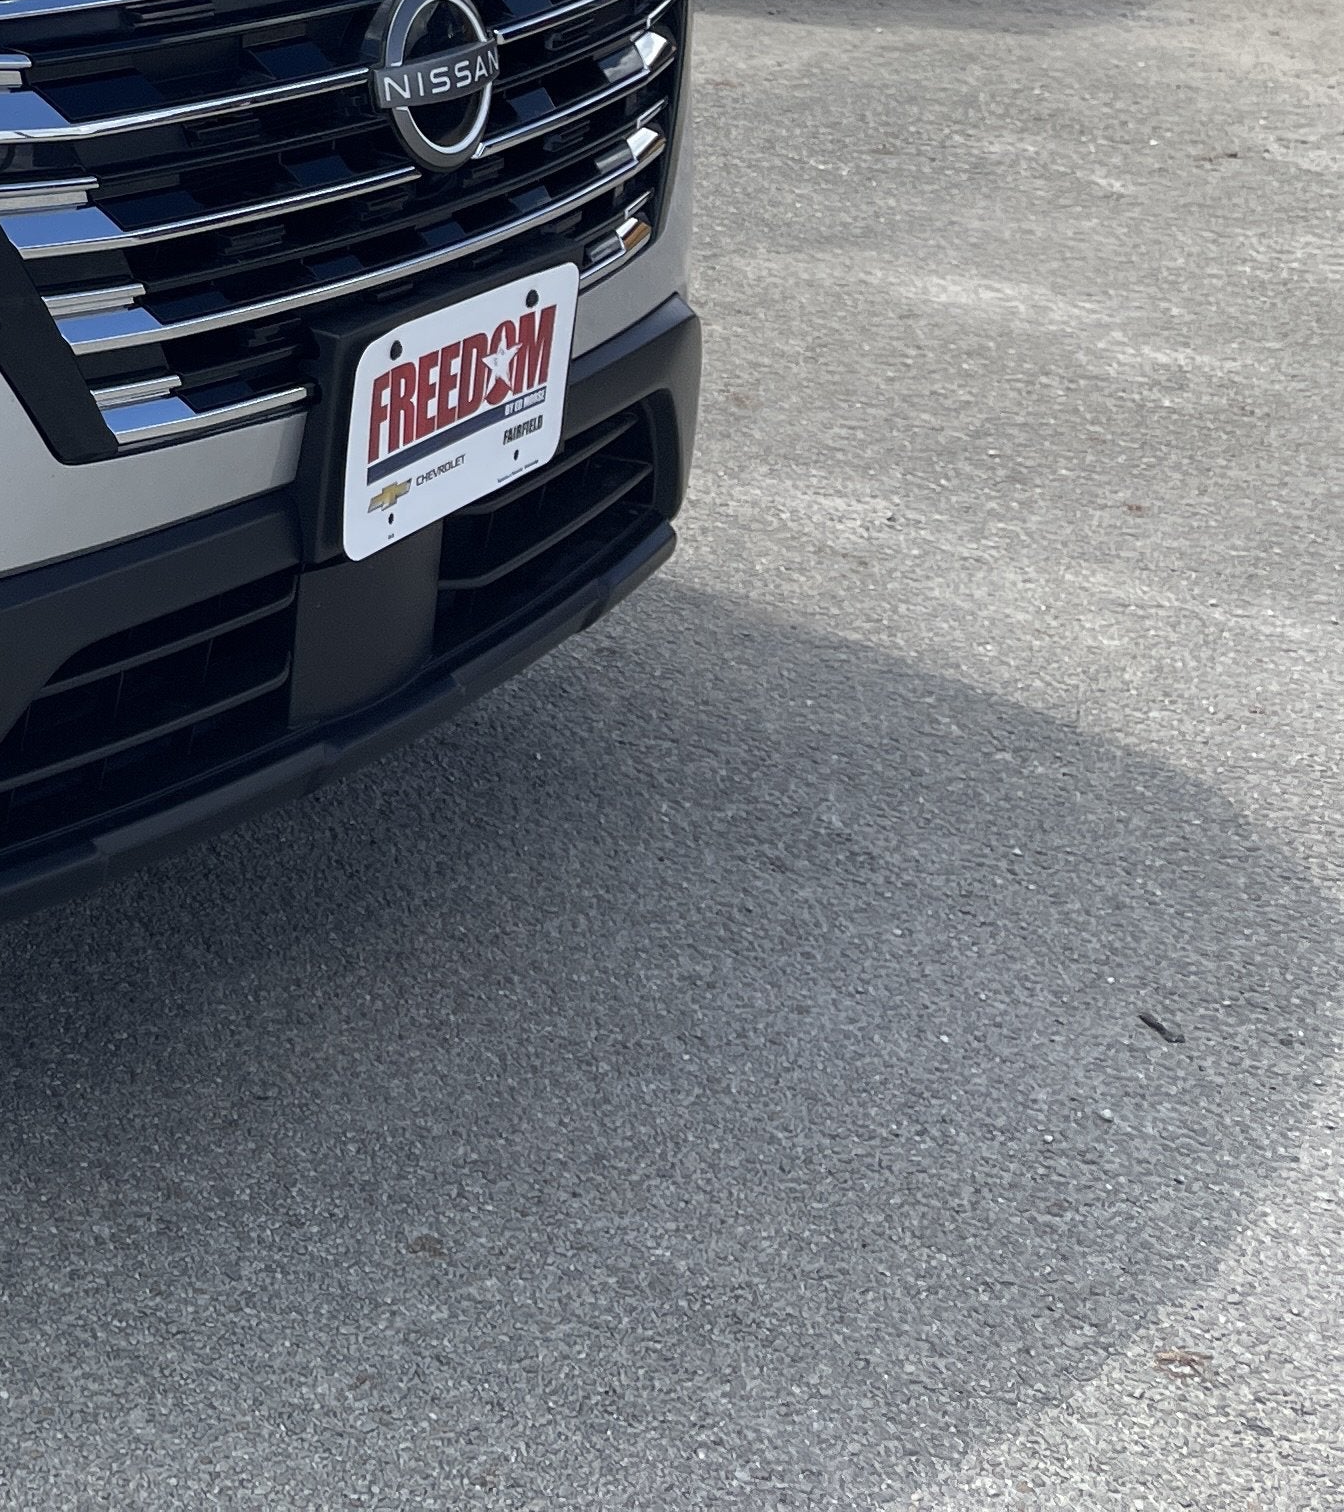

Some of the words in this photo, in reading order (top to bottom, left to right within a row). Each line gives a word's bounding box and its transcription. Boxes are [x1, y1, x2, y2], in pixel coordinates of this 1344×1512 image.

[383, 50, 499, 102] NISSAN
[368, 304, 558, 464] FREEDOM
[503, 414, 543, 445] FAIRFIELD
[415, 454, 466, 486] CHEVROLET
